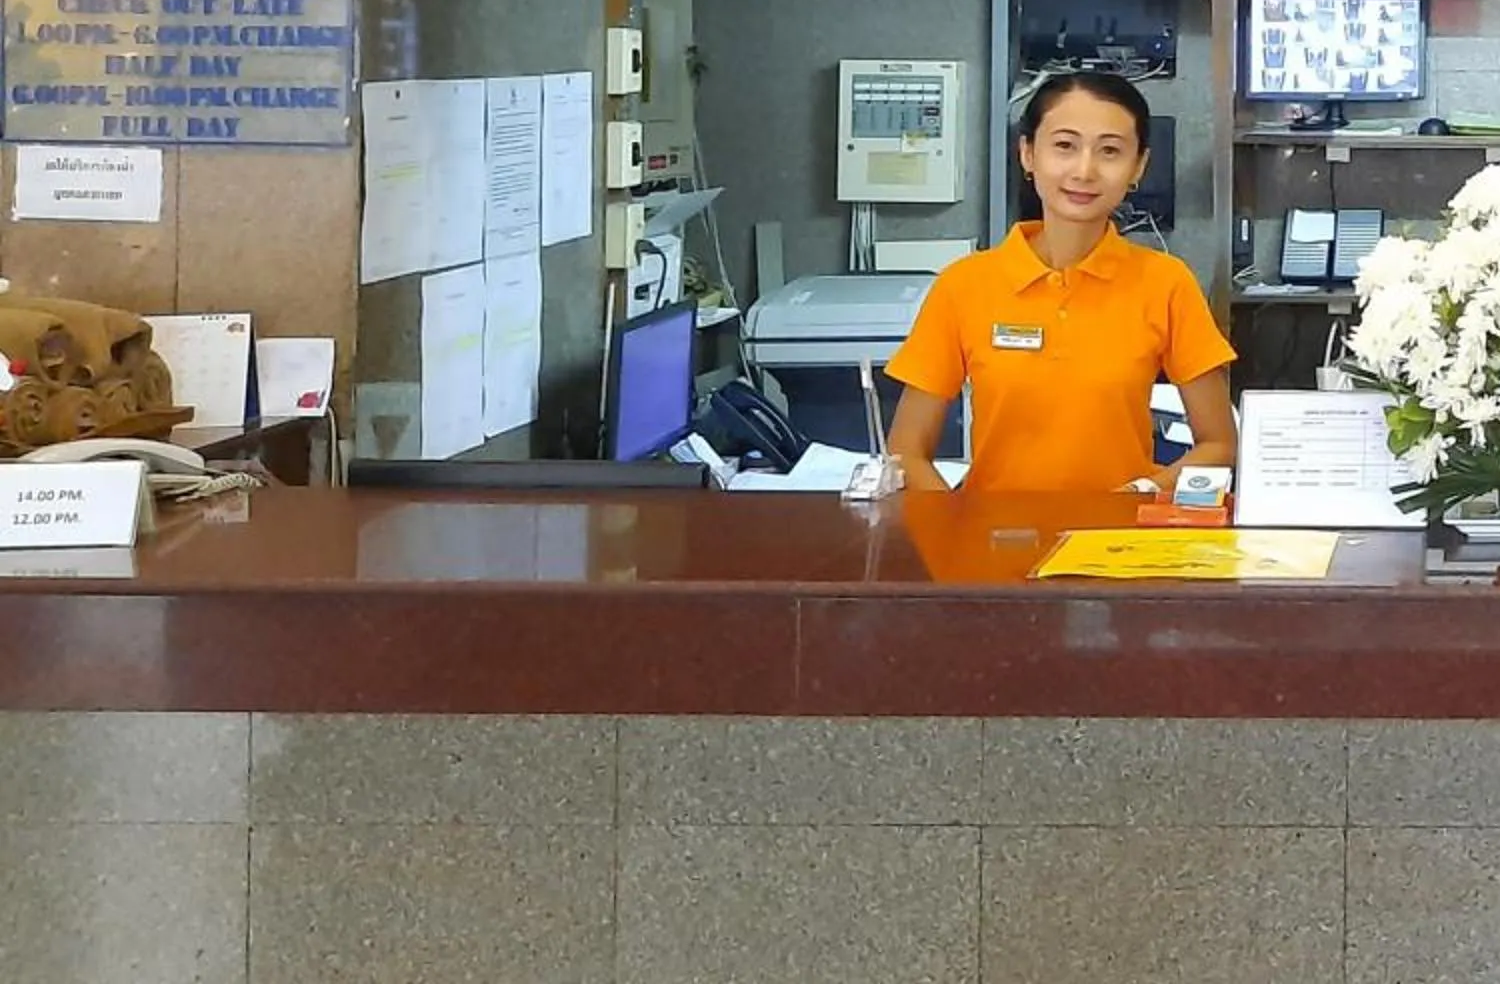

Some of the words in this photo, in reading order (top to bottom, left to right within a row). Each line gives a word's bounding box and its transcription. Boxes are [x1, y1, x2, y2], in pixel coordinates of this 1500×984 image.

[105, 55, 178, 76] HALF
[190, 56, 242, 76] DAY
[102, 116, 172, 137] FULL
[187, 117, 241, 137] DAY
